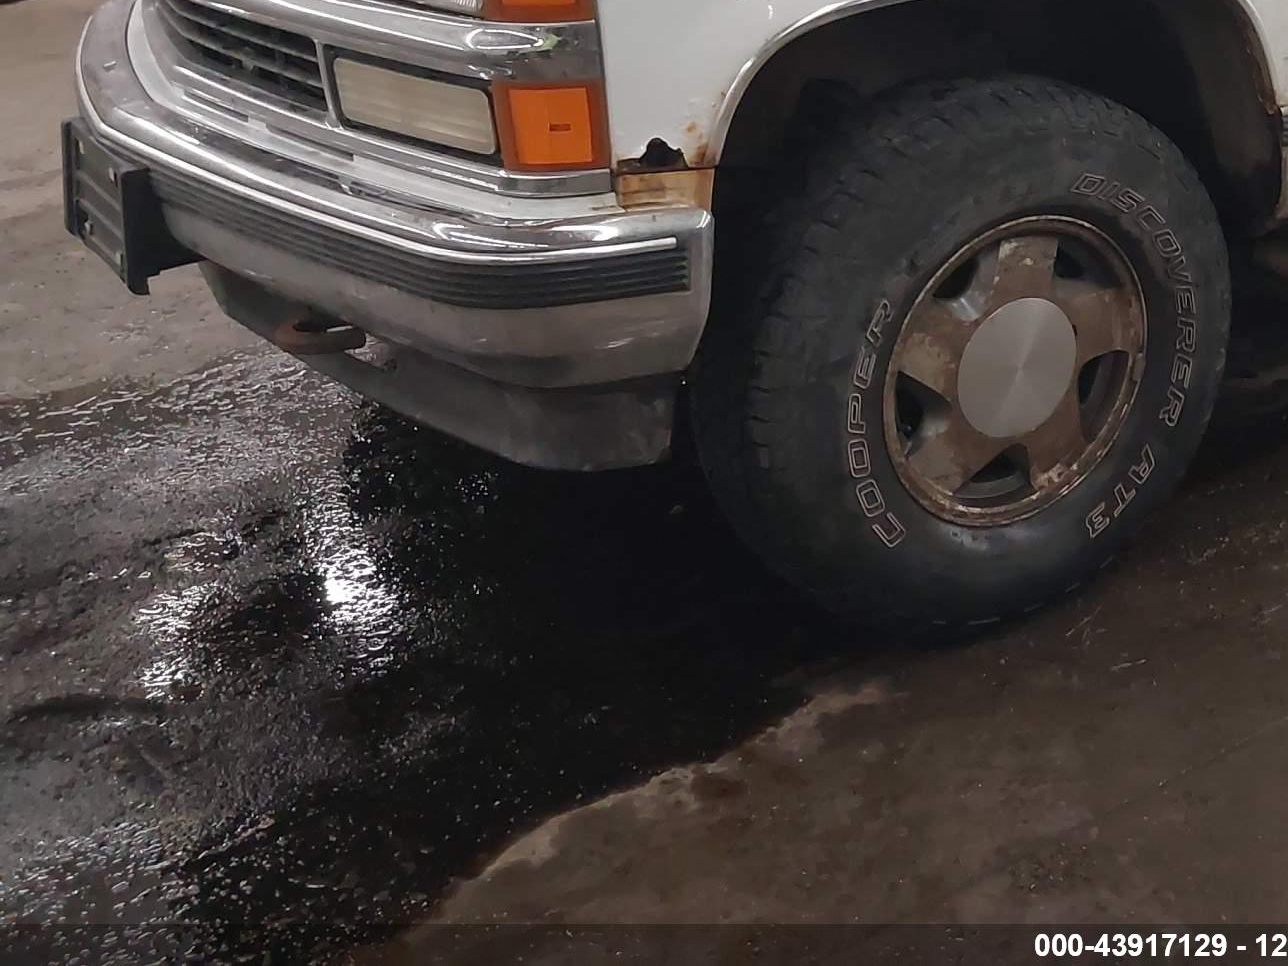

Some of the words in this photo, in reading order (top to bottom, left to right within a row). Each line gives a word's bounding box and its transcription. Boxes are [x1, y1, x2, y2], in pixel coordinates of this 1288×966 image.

[847, 298, 906, 548] COOPER
[1070, 172, 1198, 427] DISCOVERER
[1085, 442, 1156, 538] AT3
